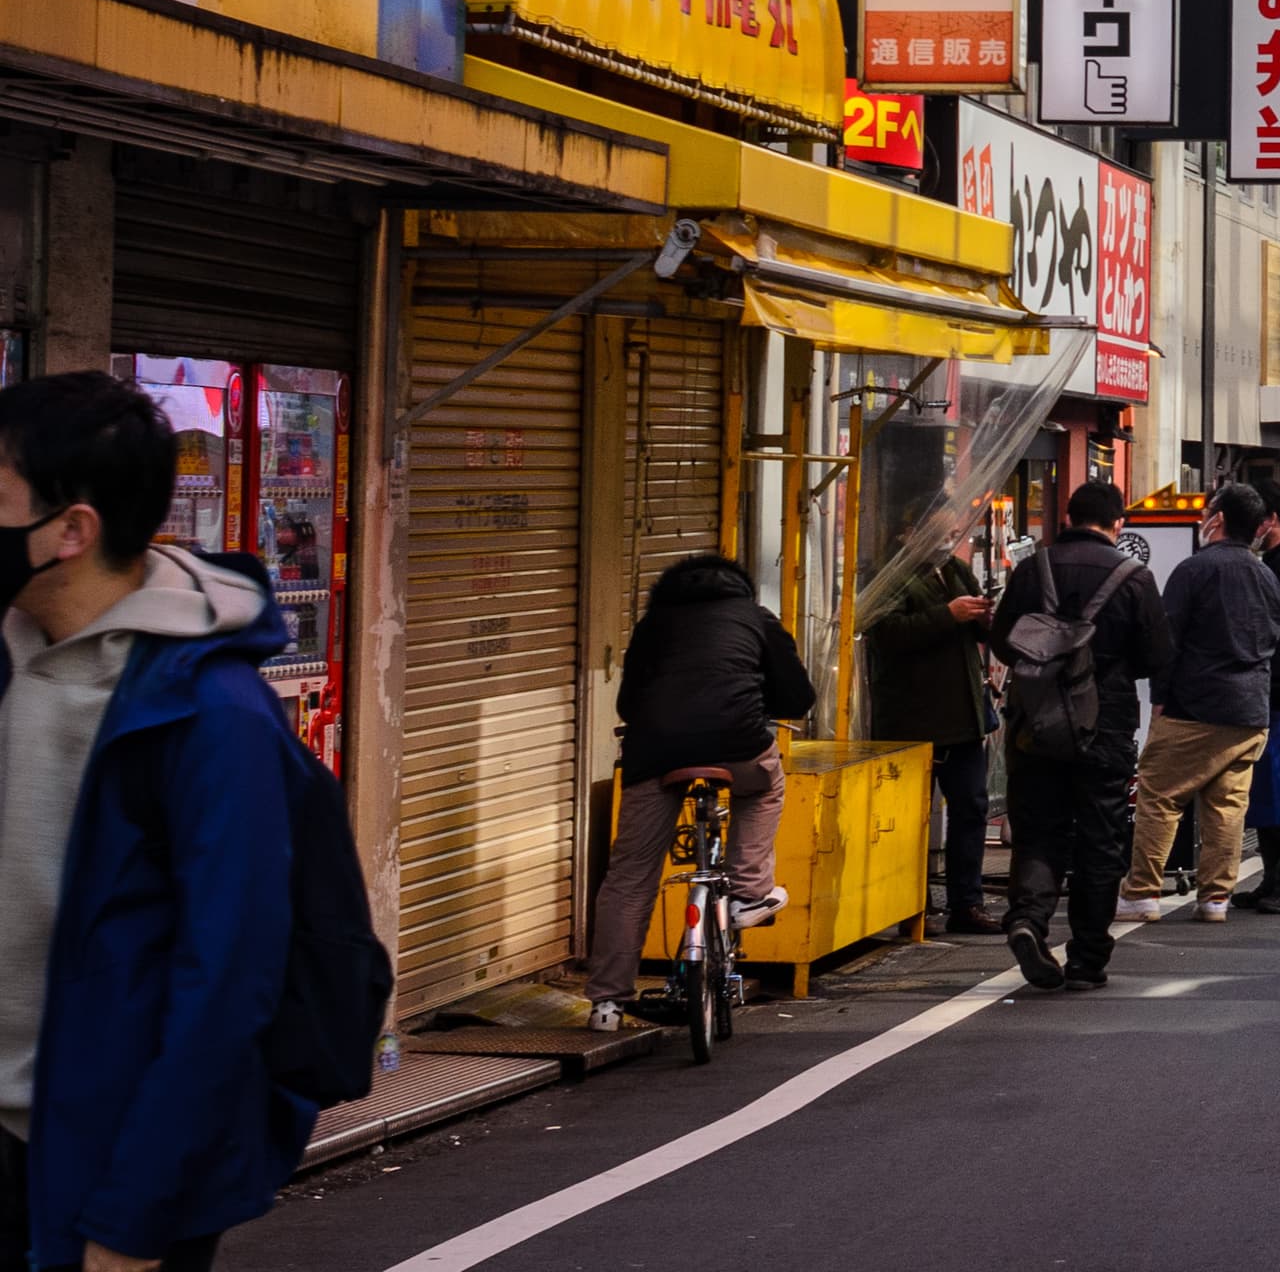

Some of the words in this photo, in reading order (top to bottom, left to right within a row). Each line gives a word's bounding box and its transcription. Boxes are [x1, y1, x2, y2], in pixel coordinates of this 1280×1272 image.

[871, 37, 1007, 67] 通信販売
[1102, 171, 1147, 267] カツ丼
[1102, 258, 1146, 335] とんかつ
